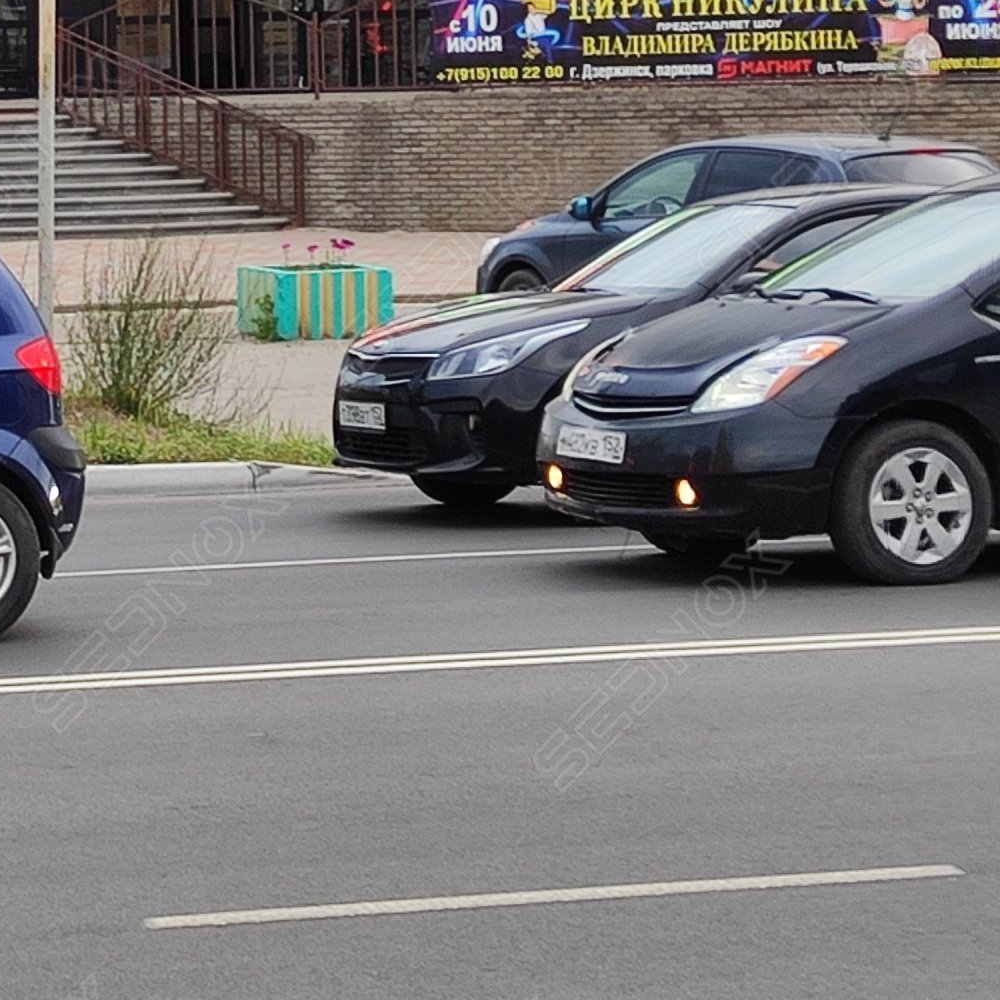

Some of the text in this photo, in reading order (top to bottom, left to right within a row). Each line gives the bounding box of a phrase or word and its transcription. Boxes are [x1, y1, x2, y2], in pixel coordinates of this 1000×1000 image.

[462, 3, 499, 33] 10
[656, 18, 782, 32] ПРЕДСТАВЛЯЕТ ШОУ
[447, 35, 503, 53] ИЮНЯ
[582, 29, 858, 58] ВЛАДИМИРА ДЕРЯБКИНА
[741, 59, 812, 74] МАГНИТ
